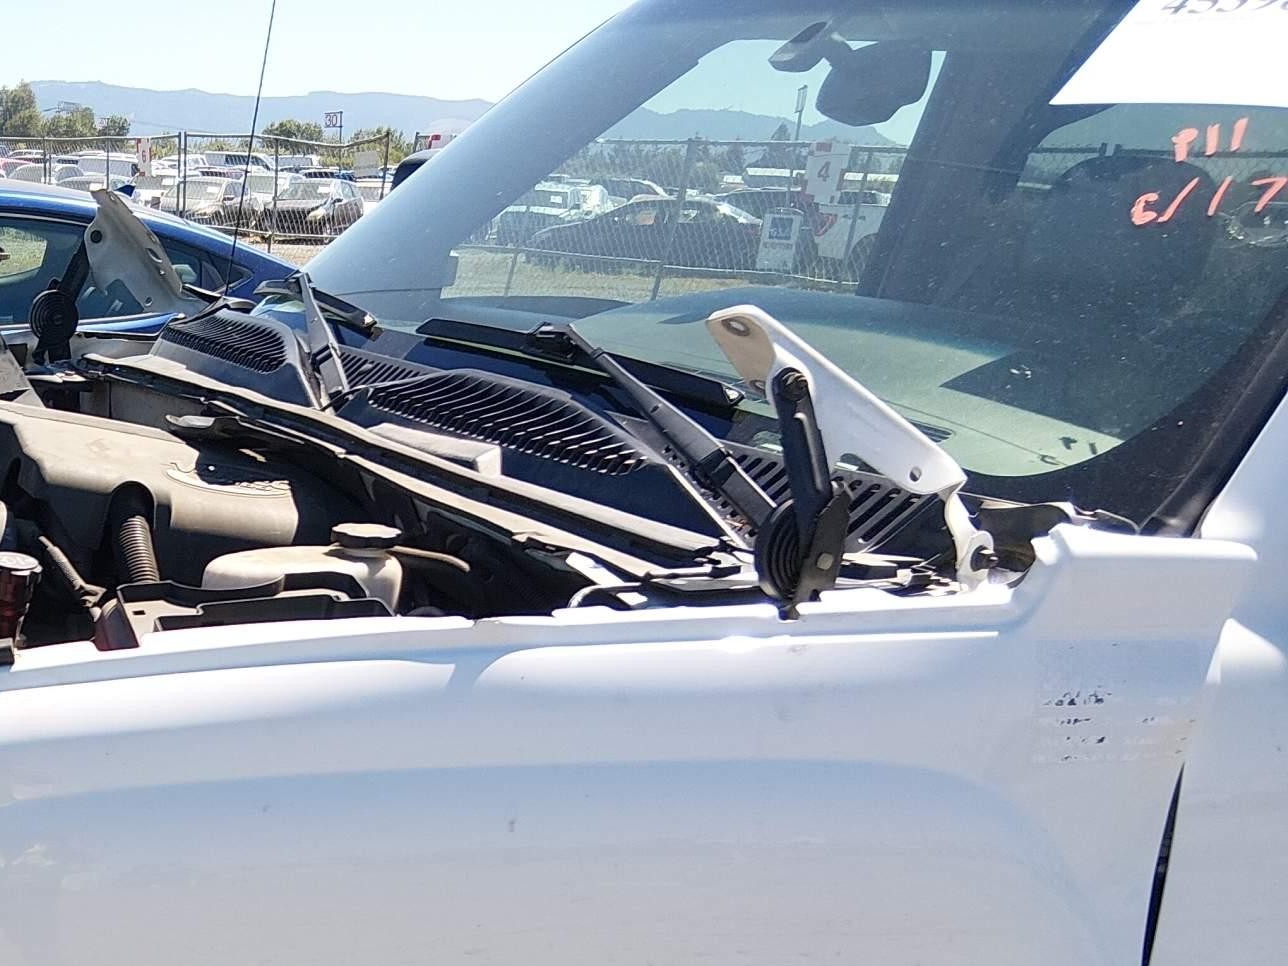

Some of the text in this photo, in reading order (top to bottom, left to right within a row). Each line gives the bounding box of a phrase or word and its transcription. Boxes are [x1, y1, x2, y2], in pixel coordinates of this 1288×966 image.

[325, 114, 338, 127] 30
[818, 161, 831, 181] 4
[1131, 176, 1288, 225] 6/17
